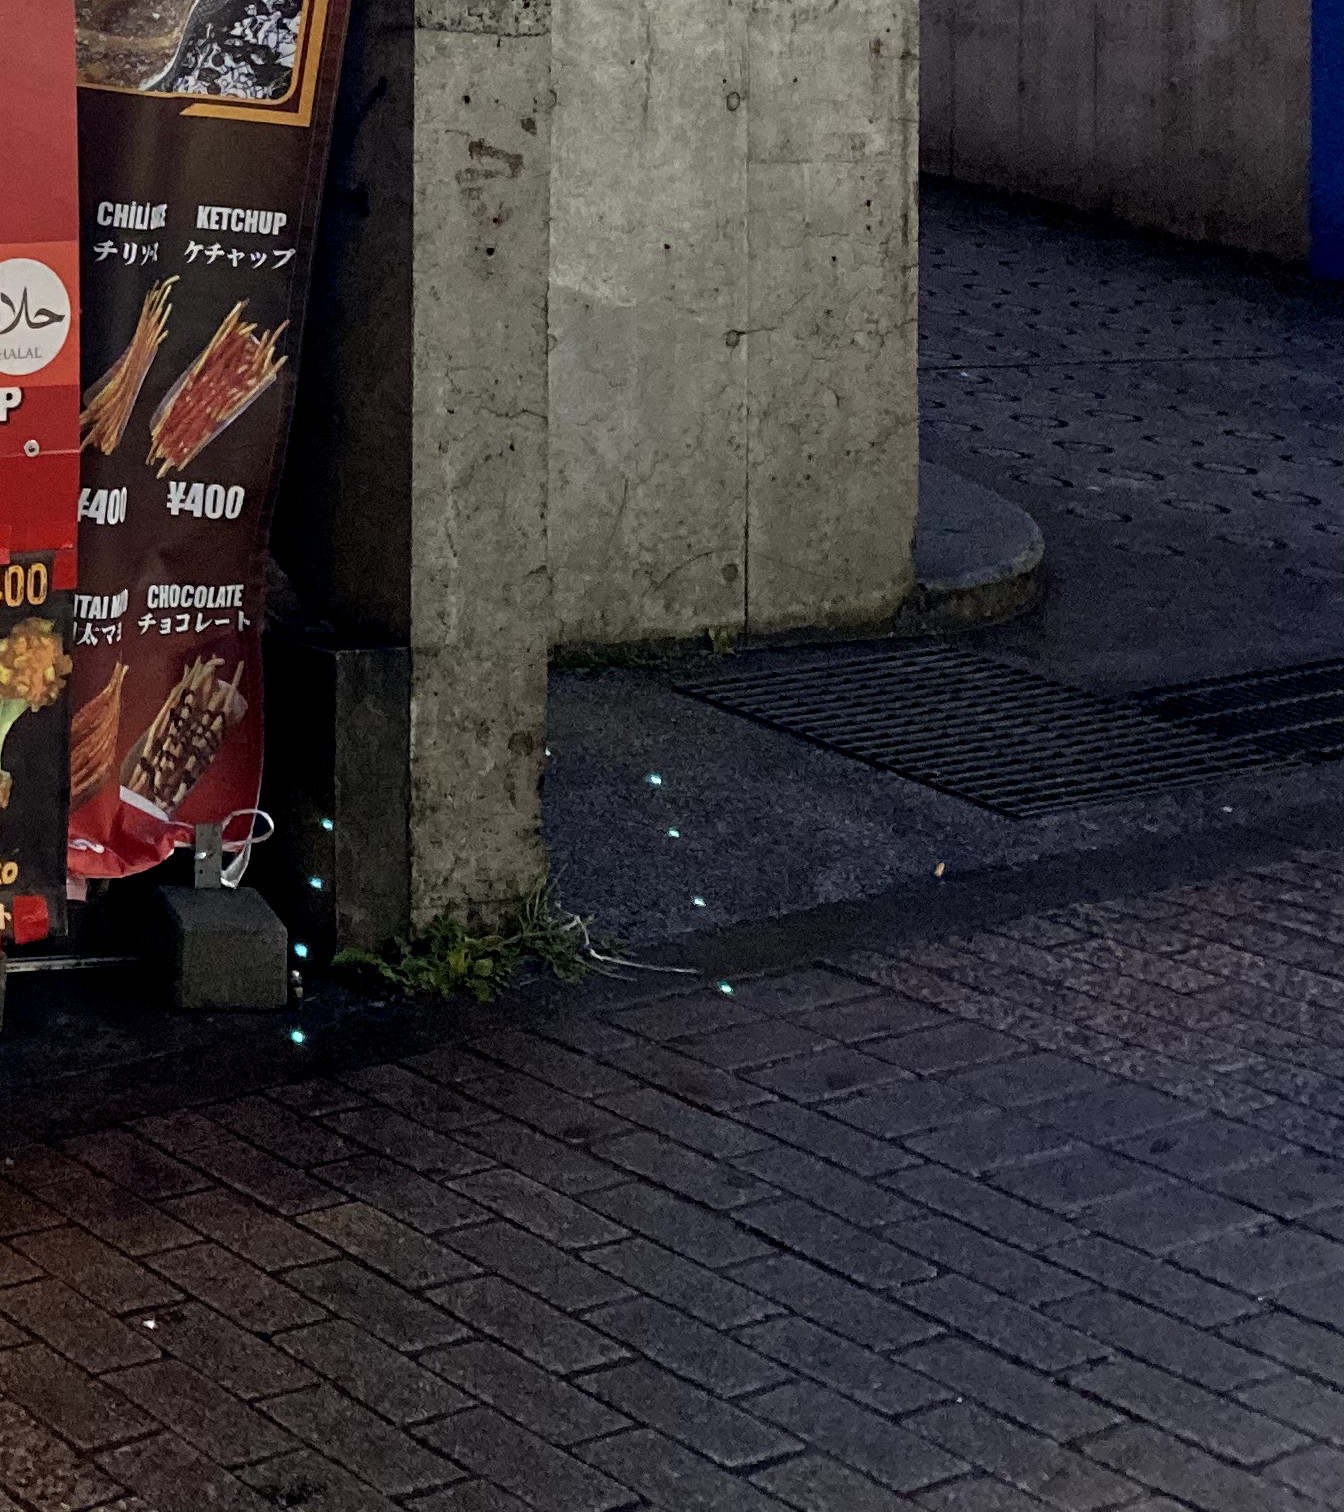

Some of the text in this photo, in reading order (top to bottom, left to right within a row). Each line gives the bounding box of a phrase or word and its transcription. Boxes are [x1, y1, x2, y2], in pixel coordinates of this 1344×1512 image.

[196, 205, 288, 236] KETCHUP
[184, 240, 297, 269] ケチャップ
[166, 481, 246, 520] ¥400
[146, 584, 245, 610] CHOCOLATE
[137, 609, 251, 635] チョコレート
